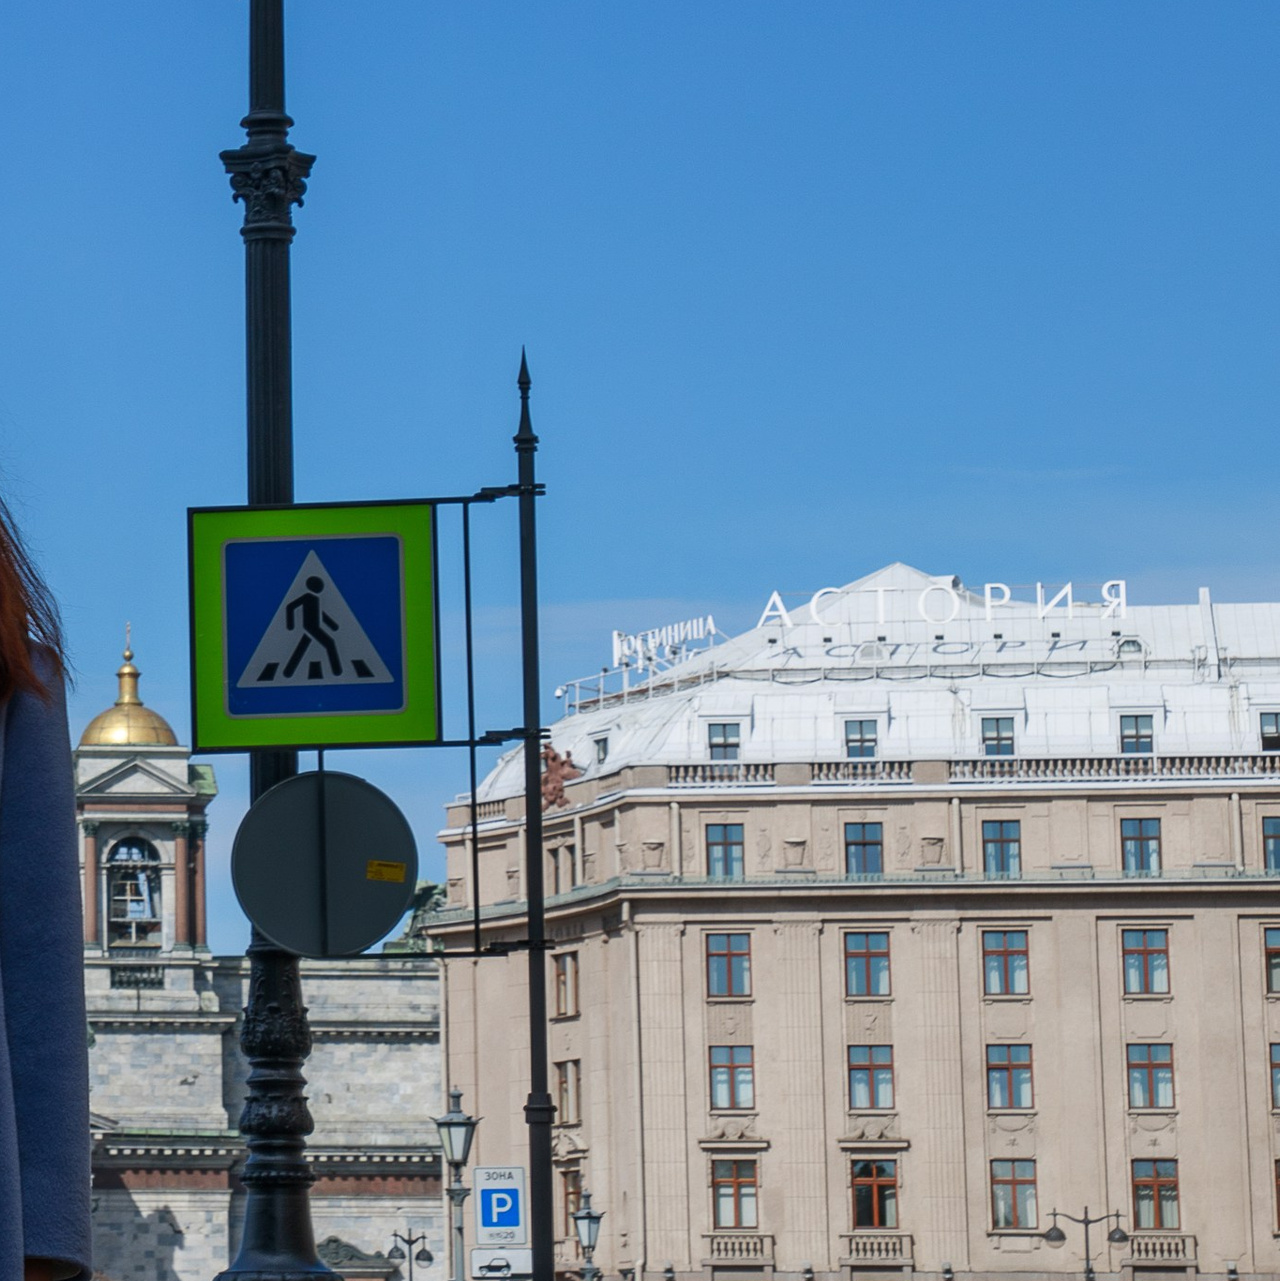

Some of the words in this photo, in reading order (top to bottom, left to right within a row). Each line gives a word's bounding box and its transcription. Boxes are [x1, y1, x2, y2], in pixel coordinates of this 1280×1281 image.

[756, 579, 1128, 628] АСТОРИЯ
[485, 1171, 513, 1180] ЗОНА
[491, 1192, 513, 1224] P
